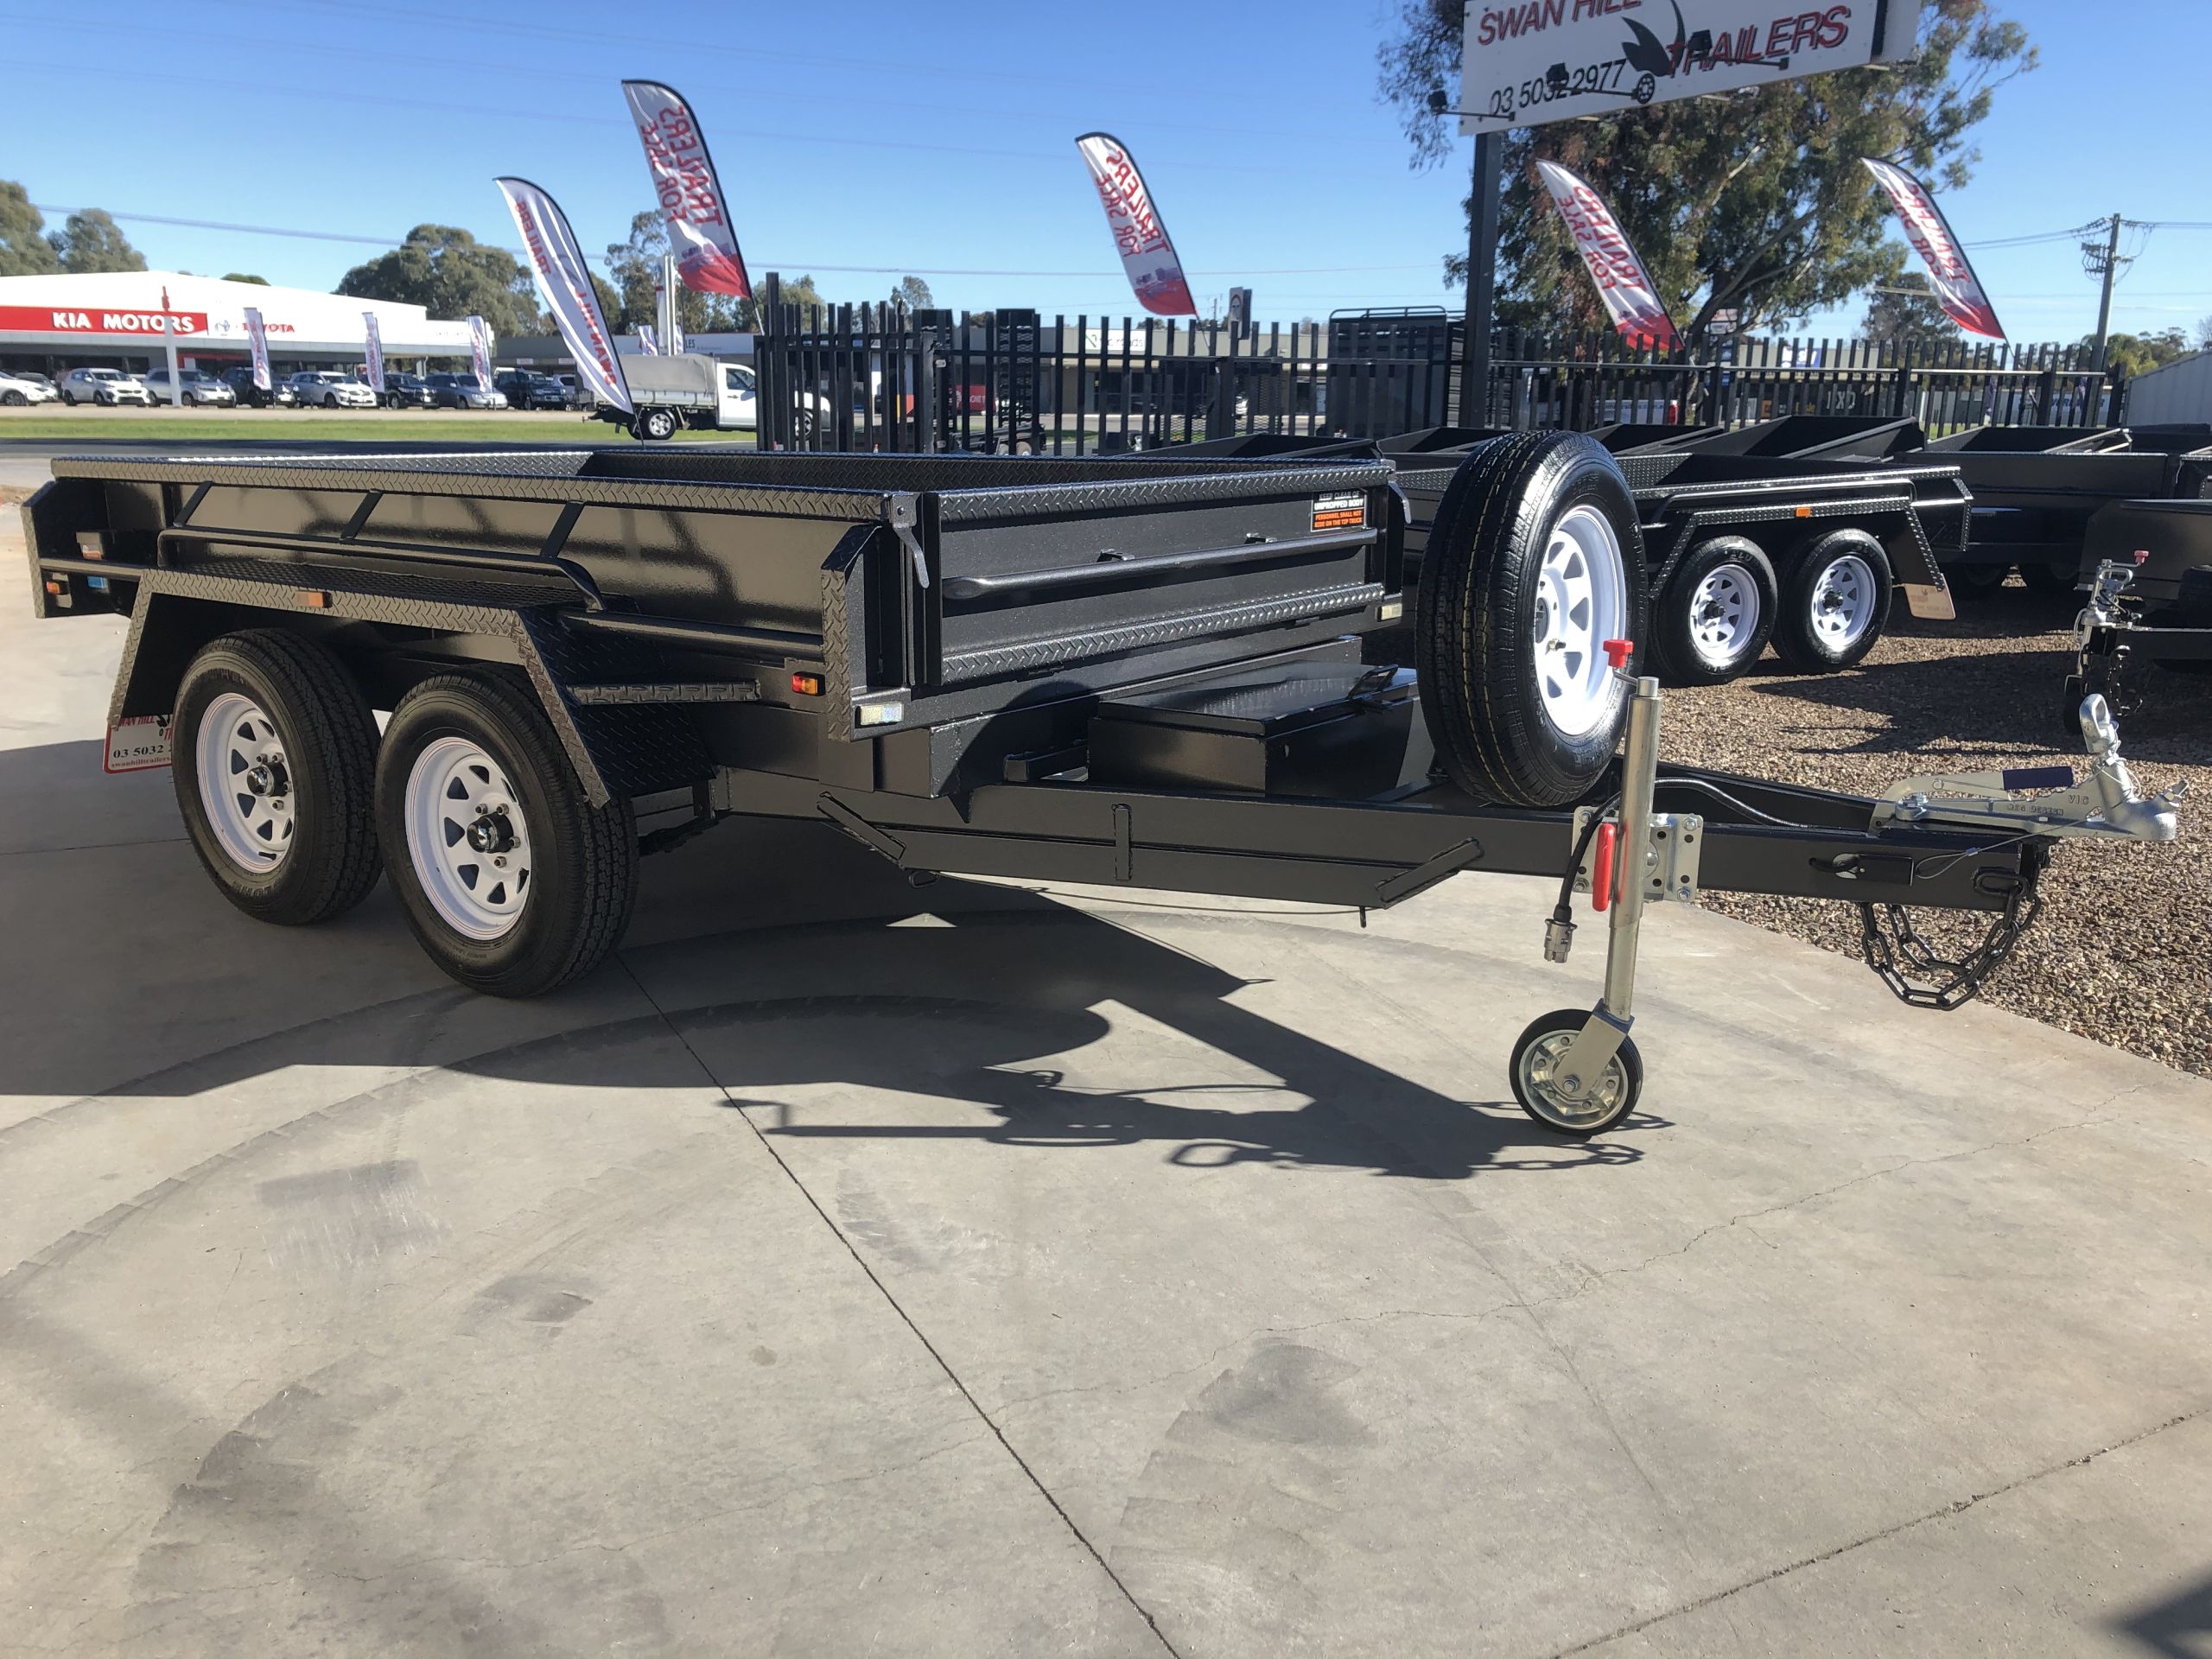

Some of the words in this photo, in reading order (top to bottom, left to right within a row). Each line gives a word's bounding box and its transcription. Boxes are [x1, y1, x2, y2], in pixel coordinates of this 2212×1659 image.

[1478, 0, 1565, 46] SWAN
[1571, 0, 1642, 22] HI
[52, 312, 92, 328] KIA
[103, 314, 195, 333] MOTORS
[242, 322, 296, 334] TYOTA
[1319, 493, 1333, 501] KEEP
[1333, 491, 1352, 500] CLEAR
[1314, 500, 1348, 510] UNPROPPED
[1348, 499, 1364, 508] BODY
[1315, 512, 1339, 521] PERSONNEL
[113, 749, 129, 759] 03
[132, 744, 164, 757] 5032
